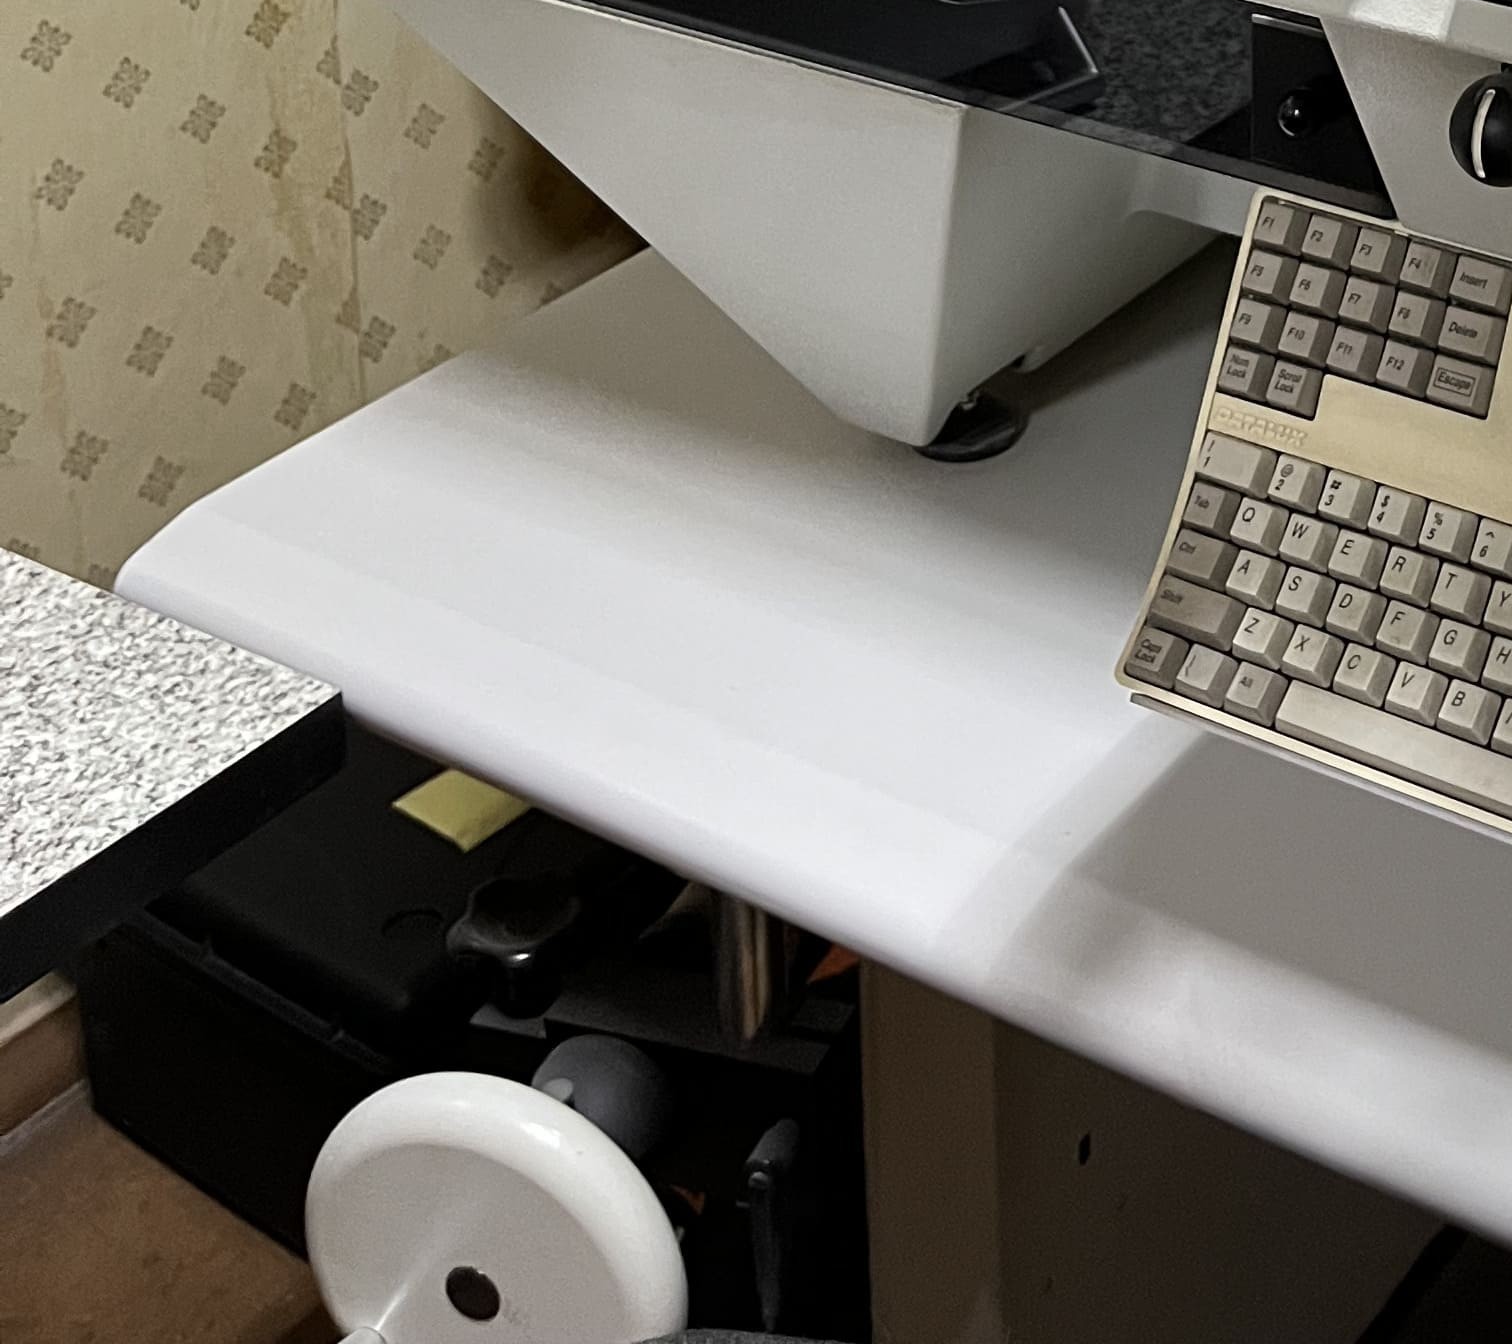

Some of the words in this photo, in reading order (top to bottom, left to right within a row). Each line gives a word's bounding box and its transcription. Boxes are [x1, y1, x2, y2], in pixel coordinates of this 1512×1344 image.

[1262, 216, 1275, 229] F1
[1310, 230, 1323, 242] F2
[1359, 243, 1371, 256] F3
[1408, 257, 1421, 269] F4
[1299, 278, 1311, 291] F6
[1459, 271, 1489, 289] Insert
[1348, 291, 1361, 304] F7
[1238, 312, 1251, 325] F9
[1287, 327, 1305, 341] F10
[1449, 321, 1478, 339] Delete
[1335, 341, 1353, 355] F11
[1386, 356, 1405, 370] F12
[1226, 365, 1247, 379] Lock
[1275, 380, 1294, 394] Lock
[1437, 372, 1472, 391] Escape
[1241, 507, 1255, 523] Q
[1291, 521, 1309, 539] W
[1340, 539, 1355, 555] E
[1238, 559, 1251, 576] A
[1391, 556, 1407, 572] R
[1288, 575, 1302, 592] S
[1446, 573, 1458, 589] T
[1339, 593, 1353, 609] D
[1499, 591, 1512, 607] Y
[1244, 617, 1260, 634] Z
[1390, 610, 1405, 625] F
[1294, 635, 1311, 652] X
[1443, 630, 1458, 645] G
[1347, 654, 1361, 670] C
[1496, 647, 1512, 664] H
[1400, 672, 1415, 688] V
[1451, 691, 1466, 707] B
